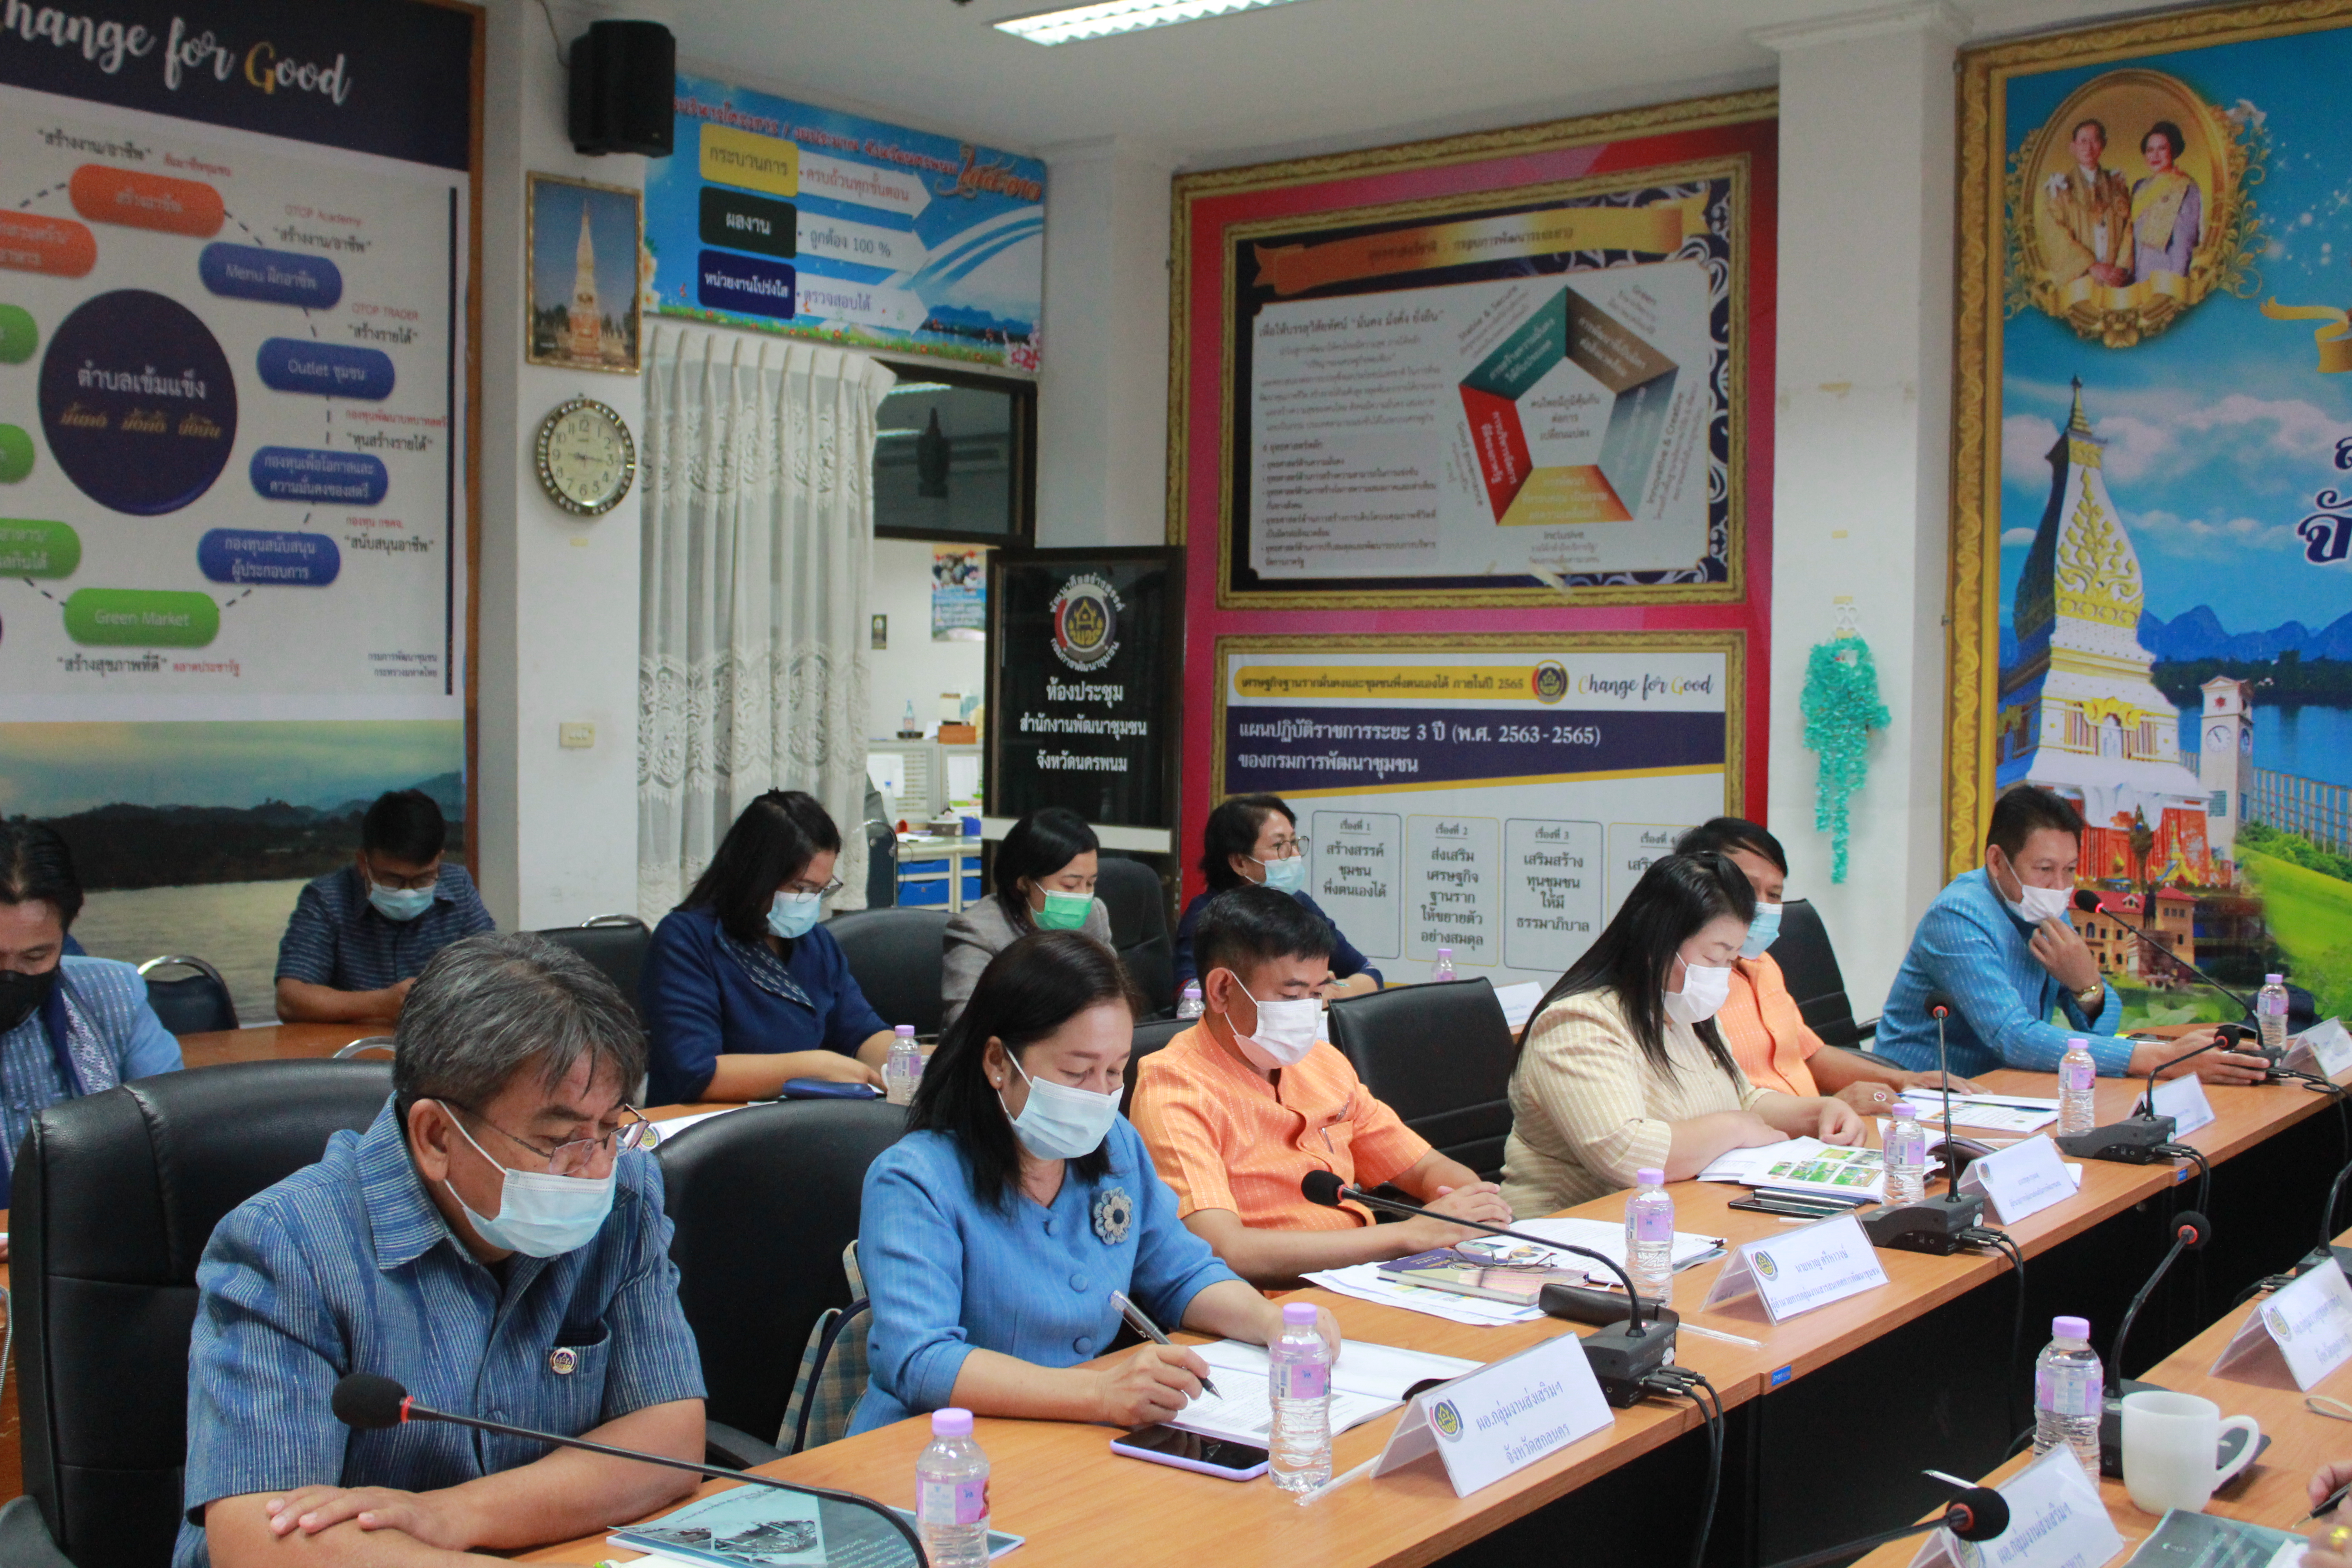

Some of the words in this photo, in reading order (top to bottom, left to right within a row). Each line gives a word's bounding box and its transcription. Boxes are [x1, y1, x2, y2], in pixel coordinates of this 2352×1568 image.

[2, 0, 157, 74] hange
[163, 16, 236, 90] for
[245, 42, 353, 106] Good
[710, 146, 788, 176] กระบวนการ
[807, 167, 910, 201] ครบถ้วนทุกขั้นตอน
[284, 204, 314, 218] OTOP
[726, 210, 772, 236] ผลงาน
[810, 228, 847, 250] ถูกต้อง
[853, 238, 873, 253] 100
[878, 244, 891, 256] %
[227, 264, 264, 283] Menu
[704, 269, 789, 299] หน่วยงานโปร่งใส
[804, 286, 871, 313] ตรวจสอบได้
[352, 302, 379, 316] OTOP
[382, 307, 419, 320] TRADER
[287, 358, 329, 376] Outlet
[78, 359, 206, 399] ตำบลเข้มแข็ง
[1544, 530, 1584, 540] Inclusive
[225, 535, 316, 559] กองทุนสนับสนุน
[231, 559, 309, 583] ผู้ประกอบการ
[95, 609, 137, 625] Green
[142, 612, 190, 627] Market
[1046, 676, 1123, 708] ห้องประชุม
[1453, 674, 1494, 690] ภายในปี
[1498, 679, 1524, 689] 2565
[1578, 674, 1638, 700] Change
[1642, 674, 1667, 701] for
[1671, 674, 1713, 695] Good
[1020, 712, 1147, 740] สำนักงานพัฒนาชุมชน
[1240, 719, 1410, 743] แผนปฏิบัติราชการระยะ
[1416, 724, 1426, 741] 3
[1432, 721, 1446, 741] ปี
[1453, 724, 1491, 744] (พ.ศ.
[1037, 749, 1127, 771] จังหวัดนครพนม
[1238, 751, 1419, 779] ของกรมการพัฒนาชุมชน
[1340, 818, 1362, 830] เรื่องที่
[1436, 822, 1459, 834] เรื่องที่
[1535, 826, 1560, 839] เรื่องที่
[1641, 831, 1667, 844] เรื่องที่
[1327, 841, 1384, 857] สร้างสรรค์
[1431, 847, 1474, 862] ส่งเสริม
[1524, 852, 1583, 867] เสริมสร้าง
[1338, 865, 1371, 881] ชุมชน
[1427, 869, 1479, 887] เศรษฐกิจ
[1323, 878, 1387, 898] พึ่งตนเองได้
[1527, 875, 1580, 892] ทุนชุมชน
[1430, 891, 1475, 905] ฐานราก
[1541, 891, 1564, 909] ให้มี
[1421, 905, 1483, 925] ให้ขยายตัว
[1516, 916, 1590, 932] ธรรมาภิบาล
[1421, 929, 1484, 951] อย่างสมดุล
[1475, 1380, 1564, 1432] ผอ.กลุ่มงานส่งเสริมฯ
[1506, 1422, 1571, 1465] จังหวัดสกลนคร
[1997, 1501, 2072, 1564] ผอ.กลุ่มงานส่งเสริมฯ
